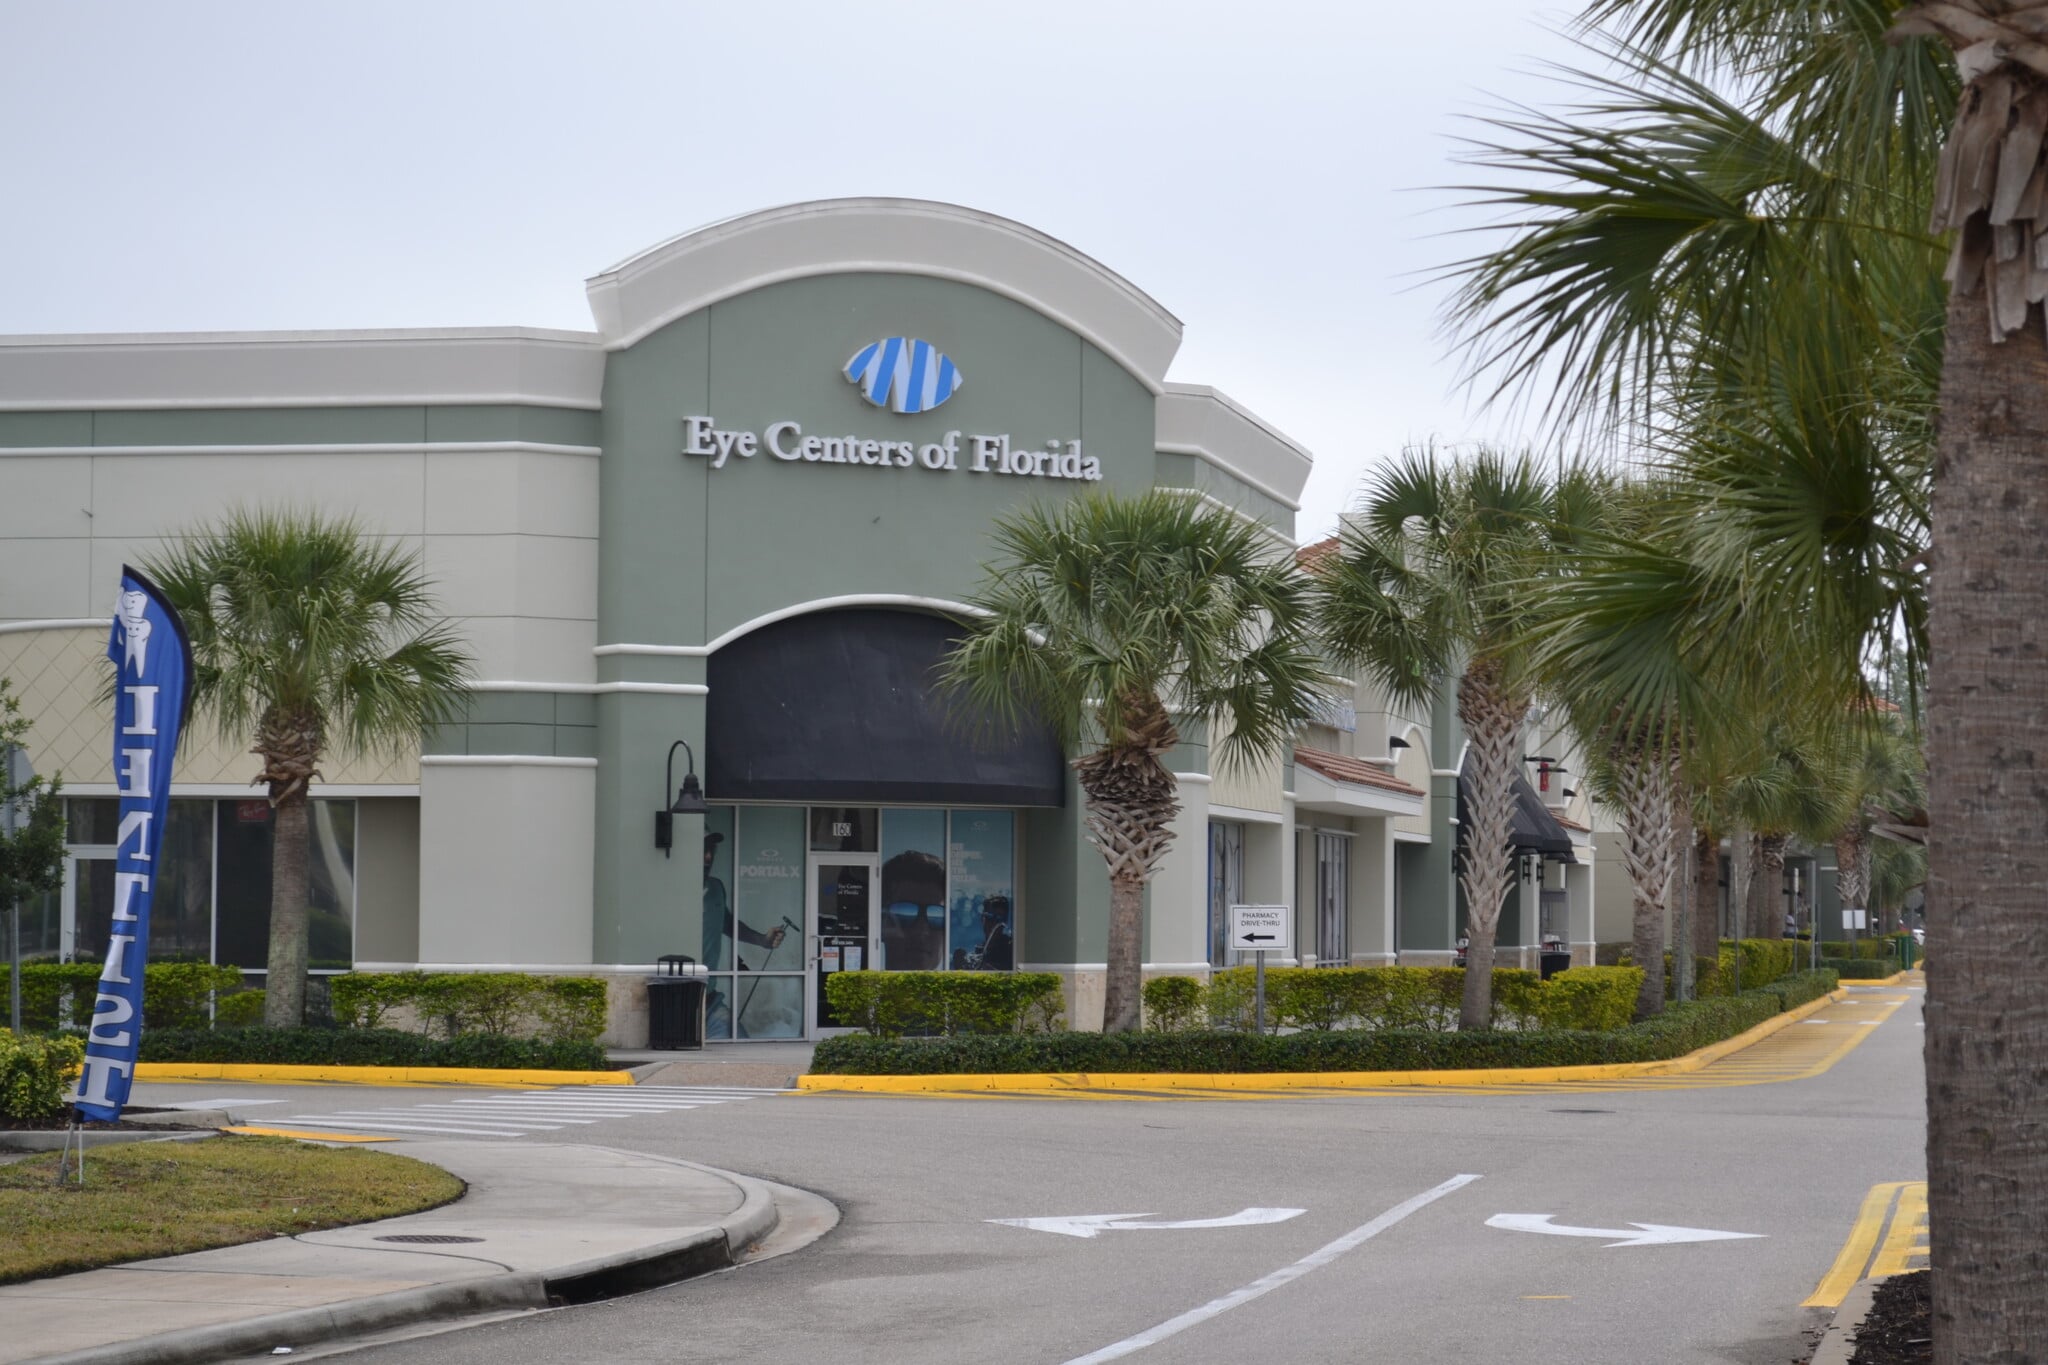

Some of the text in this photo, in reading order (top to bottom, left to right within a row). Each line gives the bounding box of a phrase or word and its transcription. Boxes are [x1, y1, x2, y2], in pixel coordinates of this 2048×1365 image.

[682, 415, 1103, 481] Eye Centers of Florida
[834, 823, 851, 836] 160
[740, 865, 800, 878] PORTAL X
